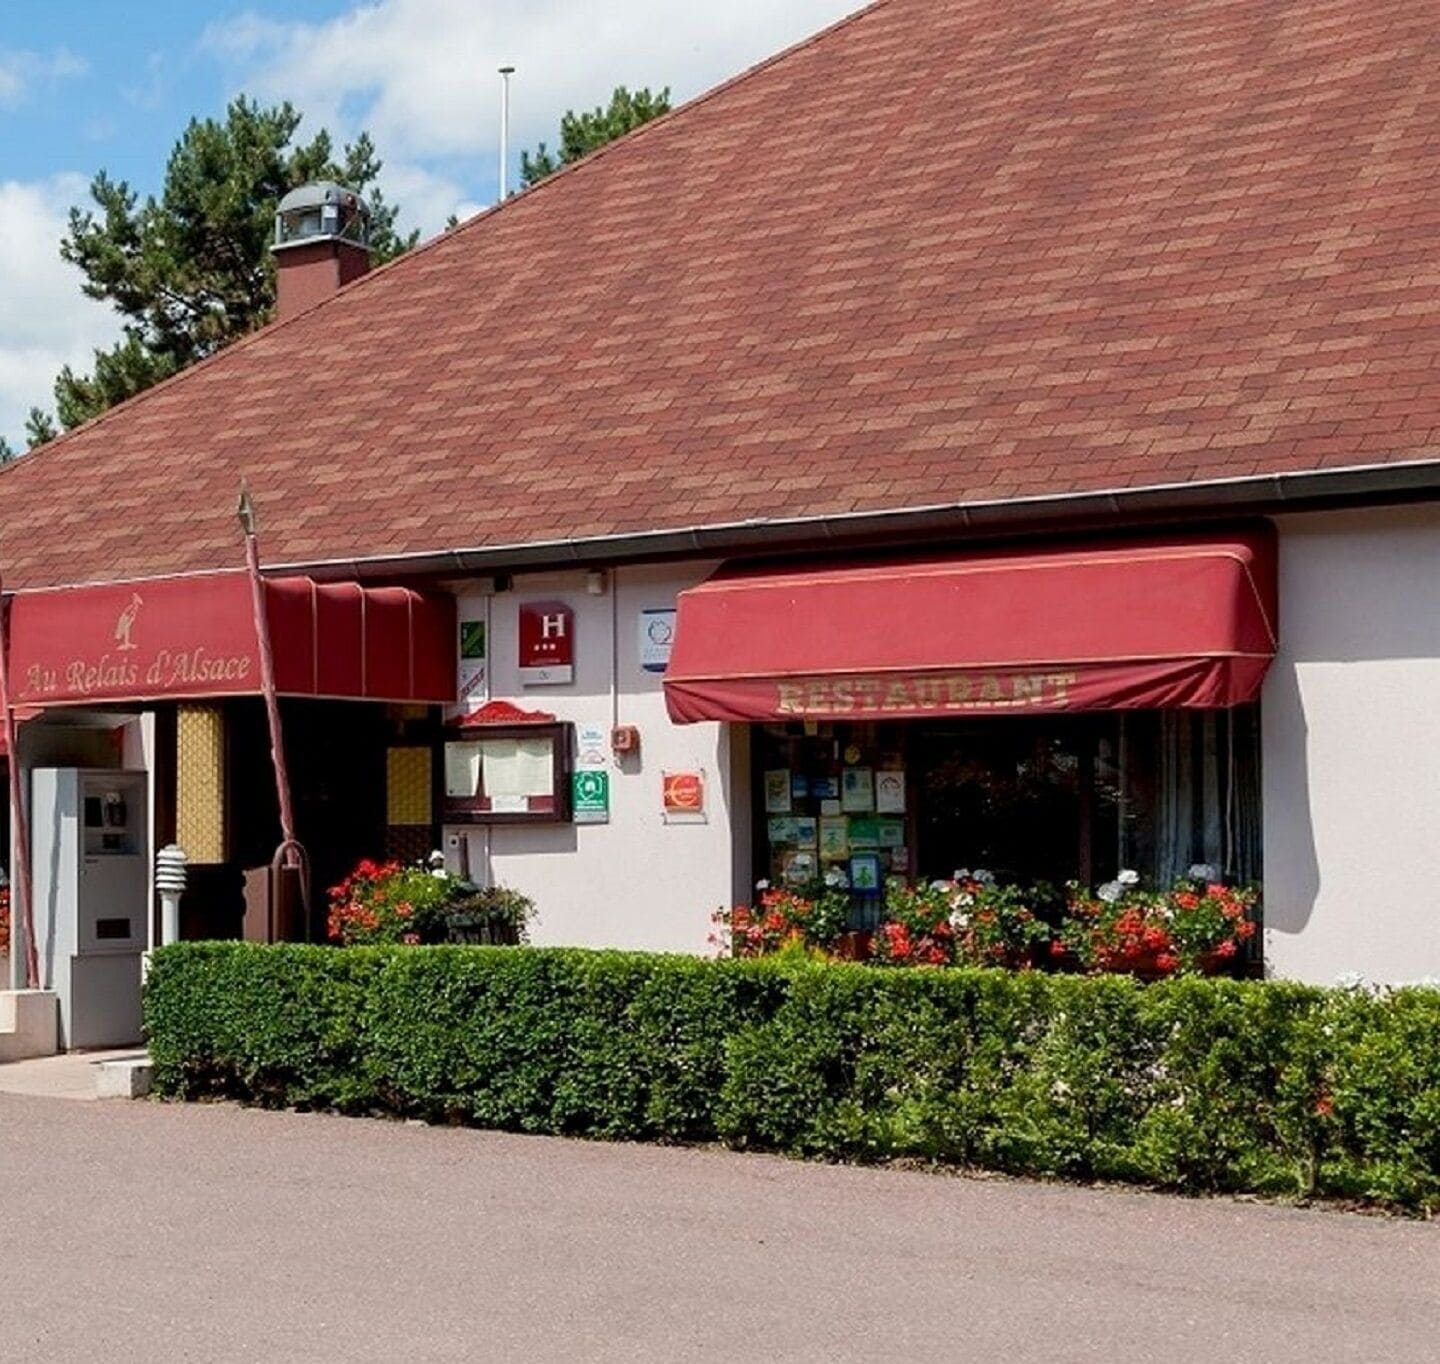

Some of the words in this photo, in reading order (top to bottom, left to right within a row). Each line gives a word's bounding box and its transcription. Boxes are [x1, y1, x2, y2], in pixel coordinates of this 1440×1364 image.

[542, 613, 565, 638] H
[19, 663, 57, 697] Au
[66, 654, 139, 695] Relais
[146, 647, 251, 688] d'Alsace
[776, 673, 1076, 713] RESTAURANT
